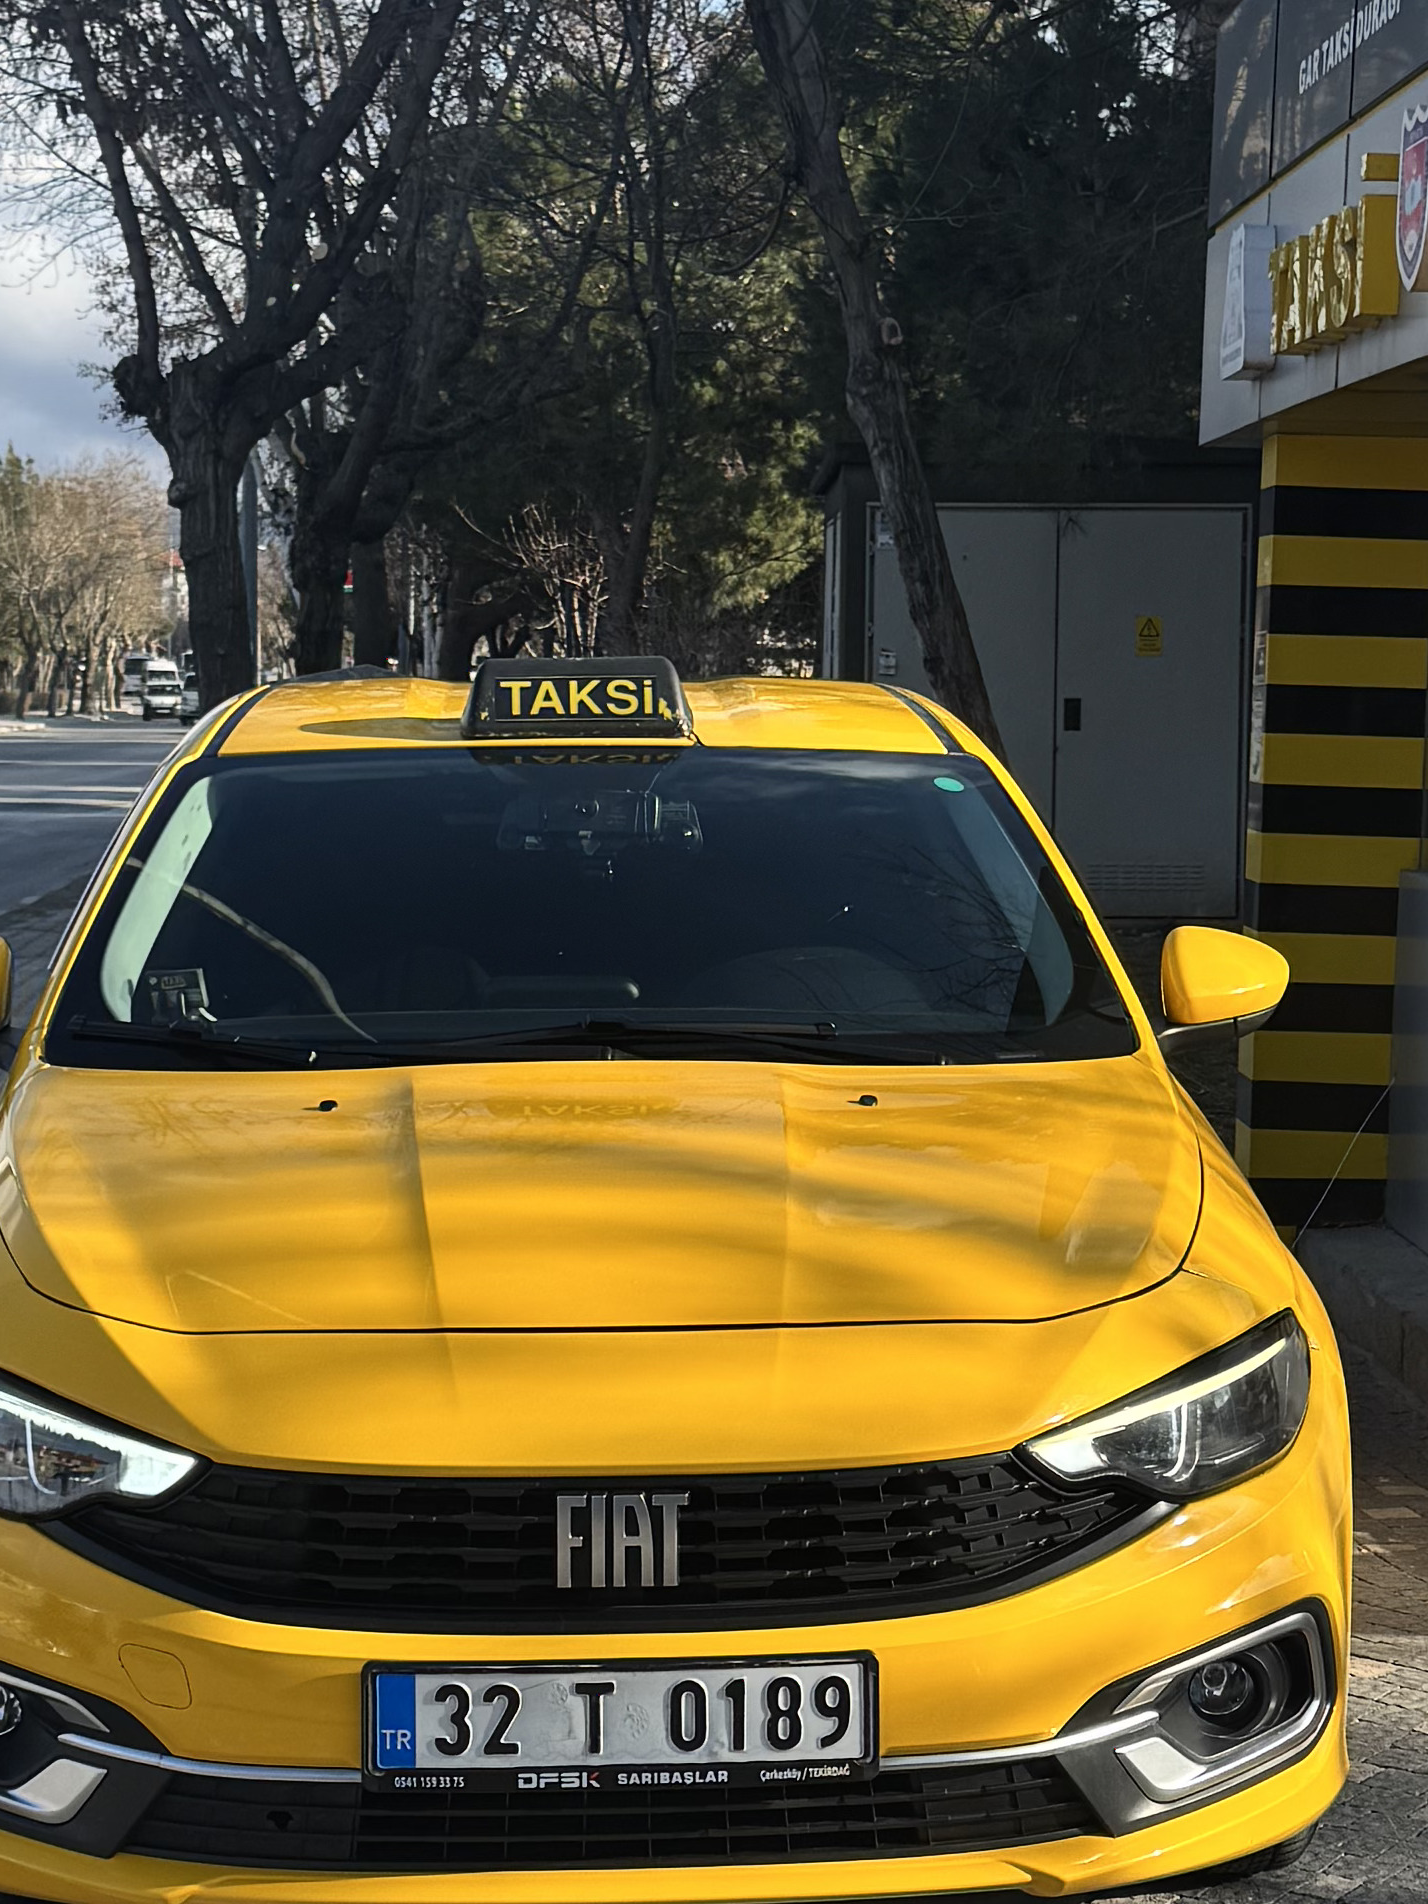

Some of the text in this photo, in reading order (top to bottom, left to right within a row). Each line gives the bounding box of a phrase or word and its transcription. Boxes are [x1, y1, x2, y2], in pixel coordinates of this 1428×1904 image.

[1298, 48, 1320, 95] GAR
[1321, 8, 1355, 77] TAKSİ
[556, 1493, 687, 1588] FIAT
[433, 1674, 852, 1757] 32 T 0189
[381, 1729, 412, 1751] TR
[394, 1776, 465, 1788] 0541 159 33 75
[518, 1772, 600, 1789] DFSK
[617, 1770, 729, 1786] SARIBAŞLAR
